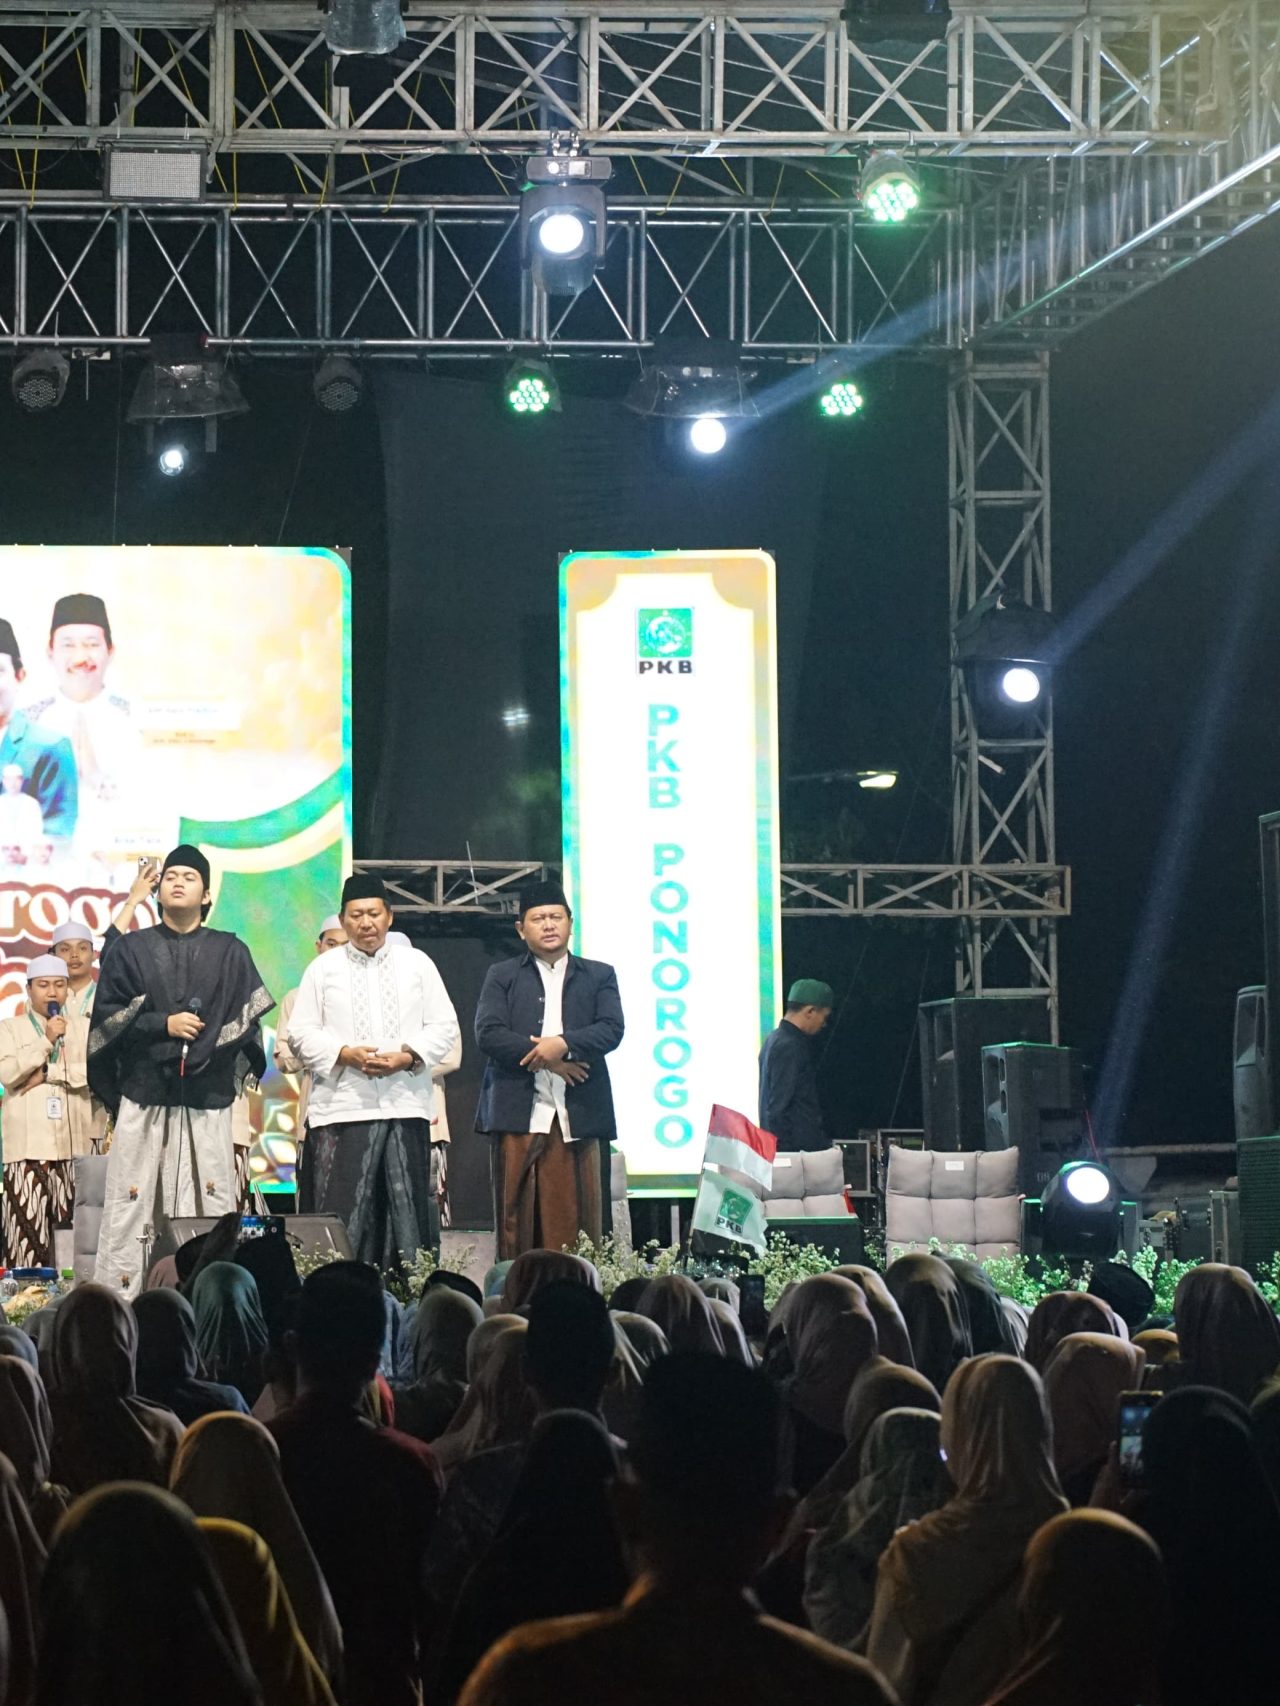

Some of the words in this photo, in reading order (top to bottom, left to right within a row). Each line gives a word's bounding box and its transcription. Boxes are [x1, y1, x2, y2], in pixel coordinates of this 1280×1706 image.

[639, 660, 692, 674] PKB
[648, 704, 680, 808] PKB
[651, 844, 693, 1148] PONOROGO
[716, 1216, 744, 1235] PKB
